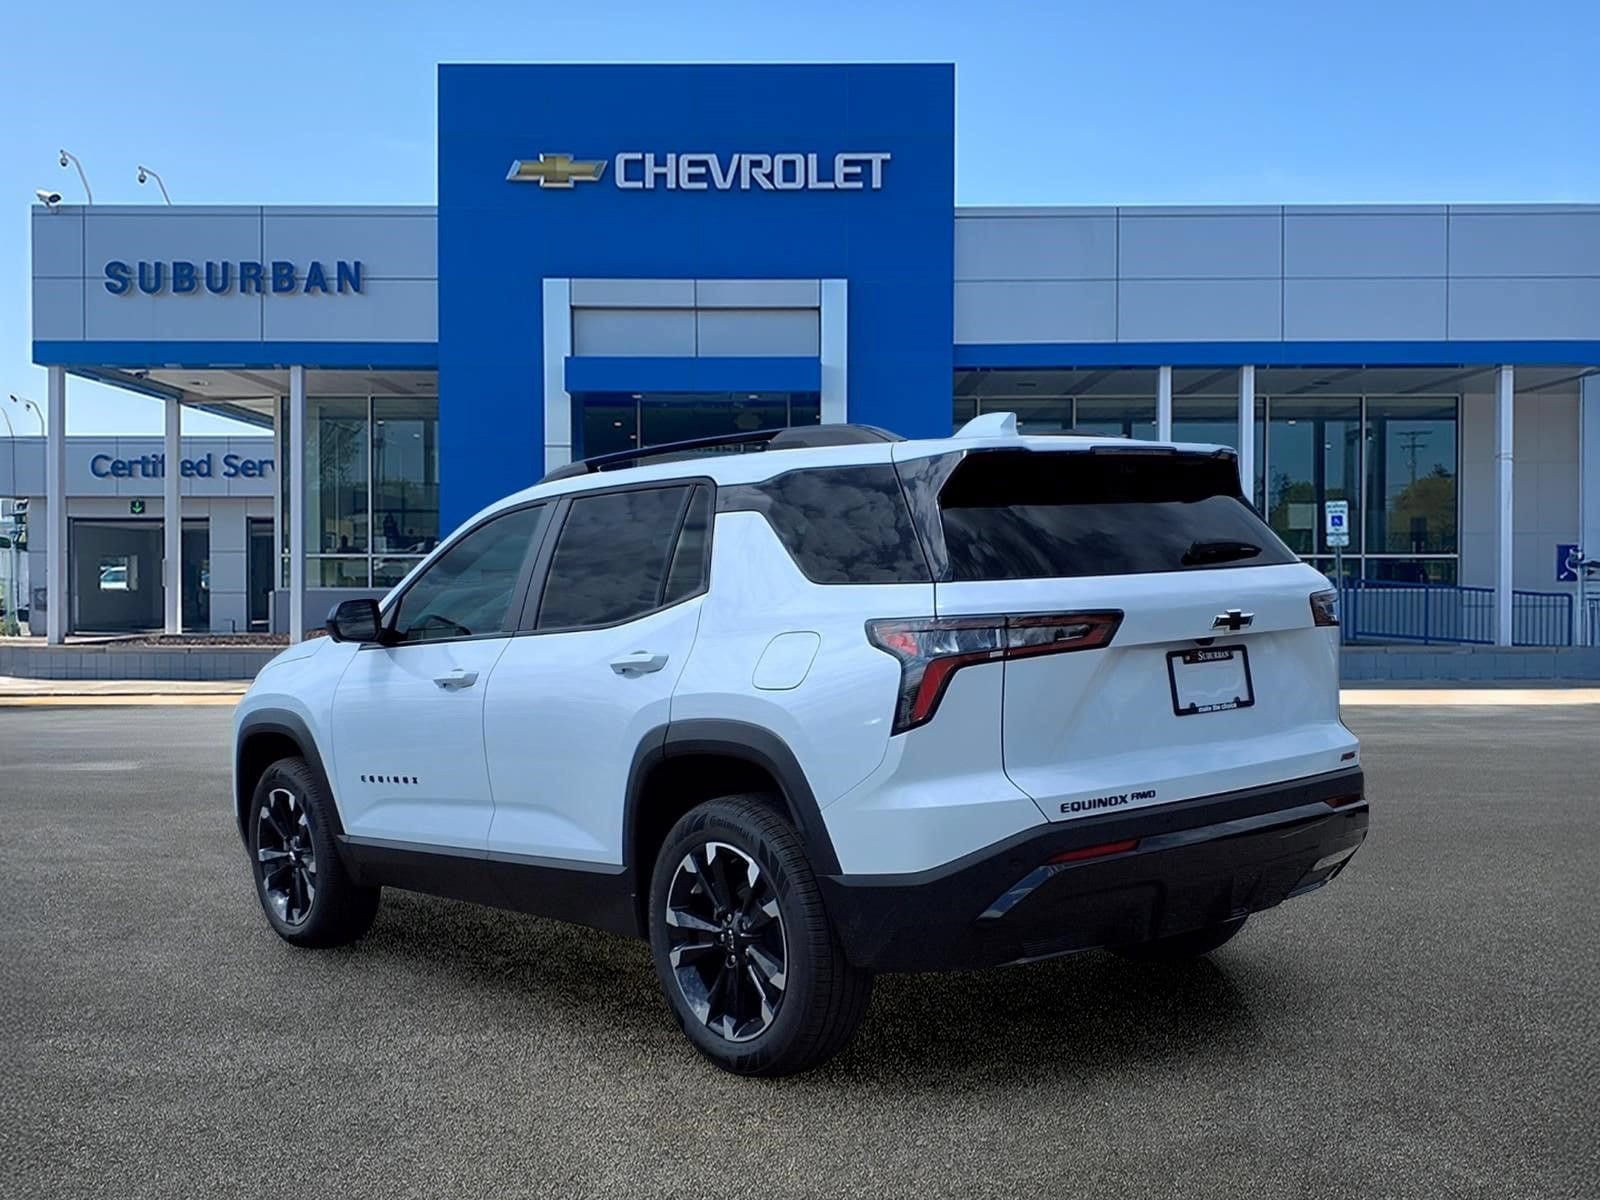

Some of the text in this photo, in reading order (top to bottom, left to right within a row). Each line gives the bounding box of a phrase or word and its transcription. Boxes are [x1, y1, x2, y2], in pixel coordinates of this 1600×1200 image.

[615, 153, 891, 190] CHEVROLET
[104, 260, 363, 295] SUBURBAN
[1060, 794, 1128, 813] EQUINOX
